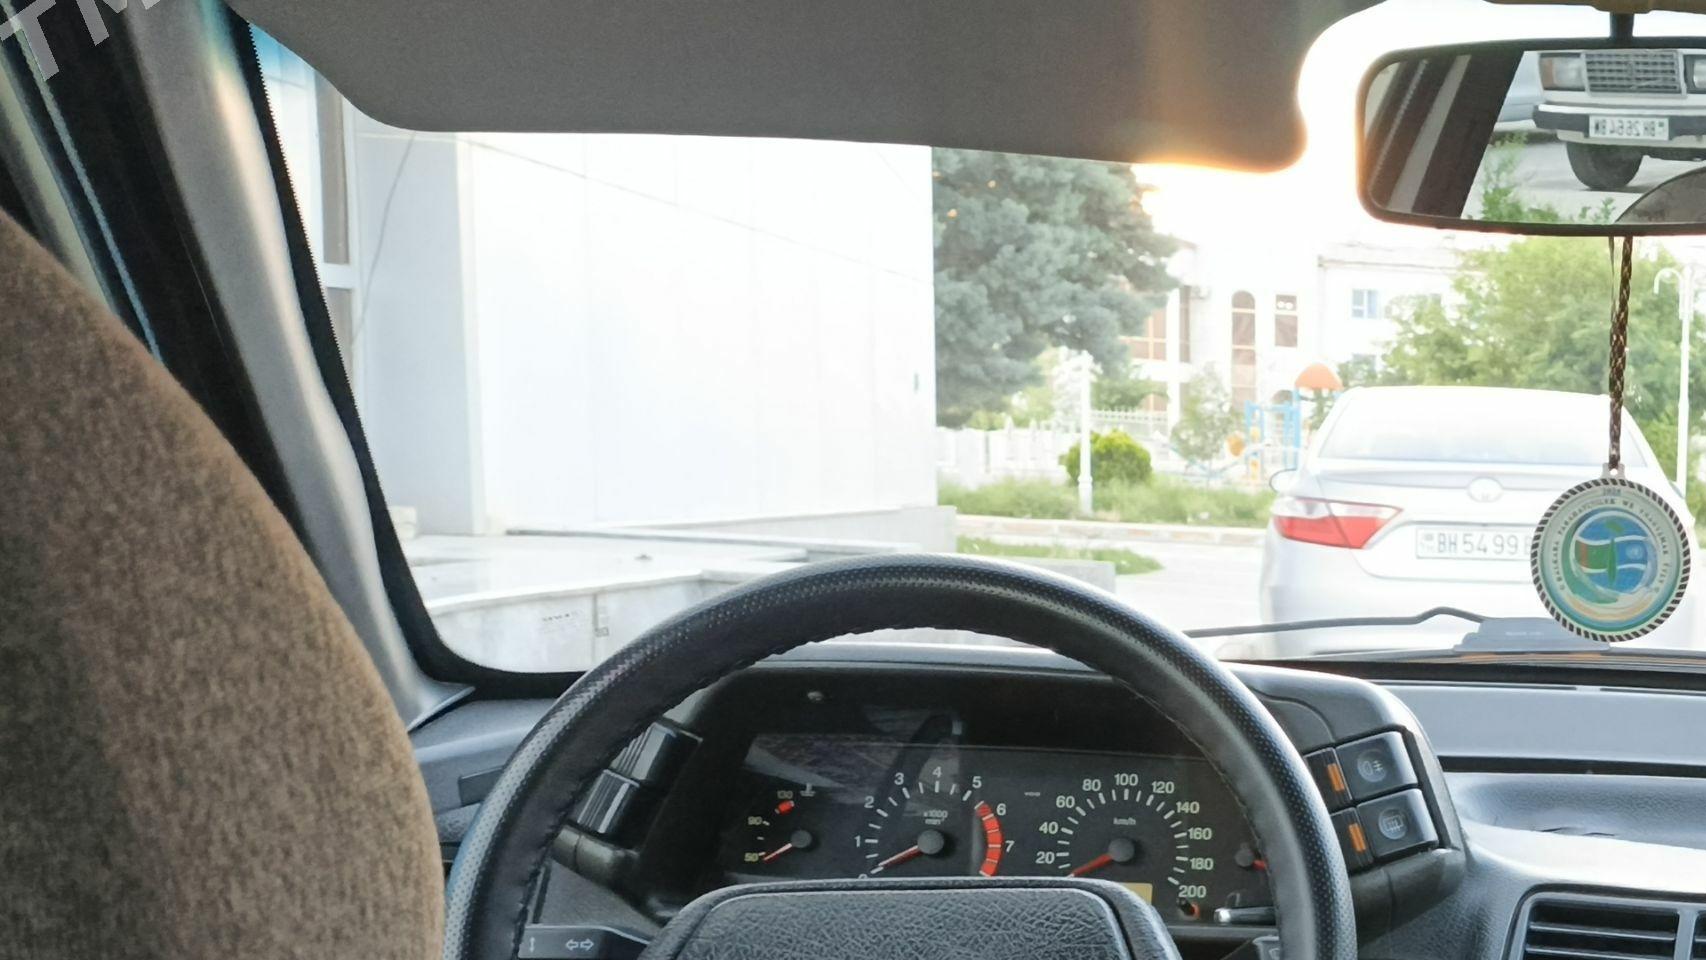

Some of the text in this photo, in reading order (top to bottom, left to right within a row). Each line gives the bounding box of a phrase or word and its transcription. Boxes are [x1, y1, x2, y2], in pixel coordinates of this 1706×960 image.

[1462, 533, 1518, 555] 5499
[932, 766, 942, 778] 4
[894, 773, 904, 786] 3
[972, 776, 982, 788] 5
[1082, 779, 1101, 791] 80
[1114, 773, 1138, 786] 100
[1152, 781, 1175, 794] 120
[864, 796, 874, 809] 2
[1056, 796, 1075, 808] 60
[1176, 801, 1200, 814] 140
[997, 804, 1006, 816] 6
[1039, 821, 1058, 834] 40
[1113, 817, 1136, 826] km/h
[1188, 827, 1212, 840] 160
[854, 836, 861, 847] 1
[1006, 840, 1015, 853] 7
[744, 852, 759, 862] 50
[1035, 851, 1055, 864] 20
[1190, 858, 1214, 870] 180
[1178, 885, 1207, 898] 200
